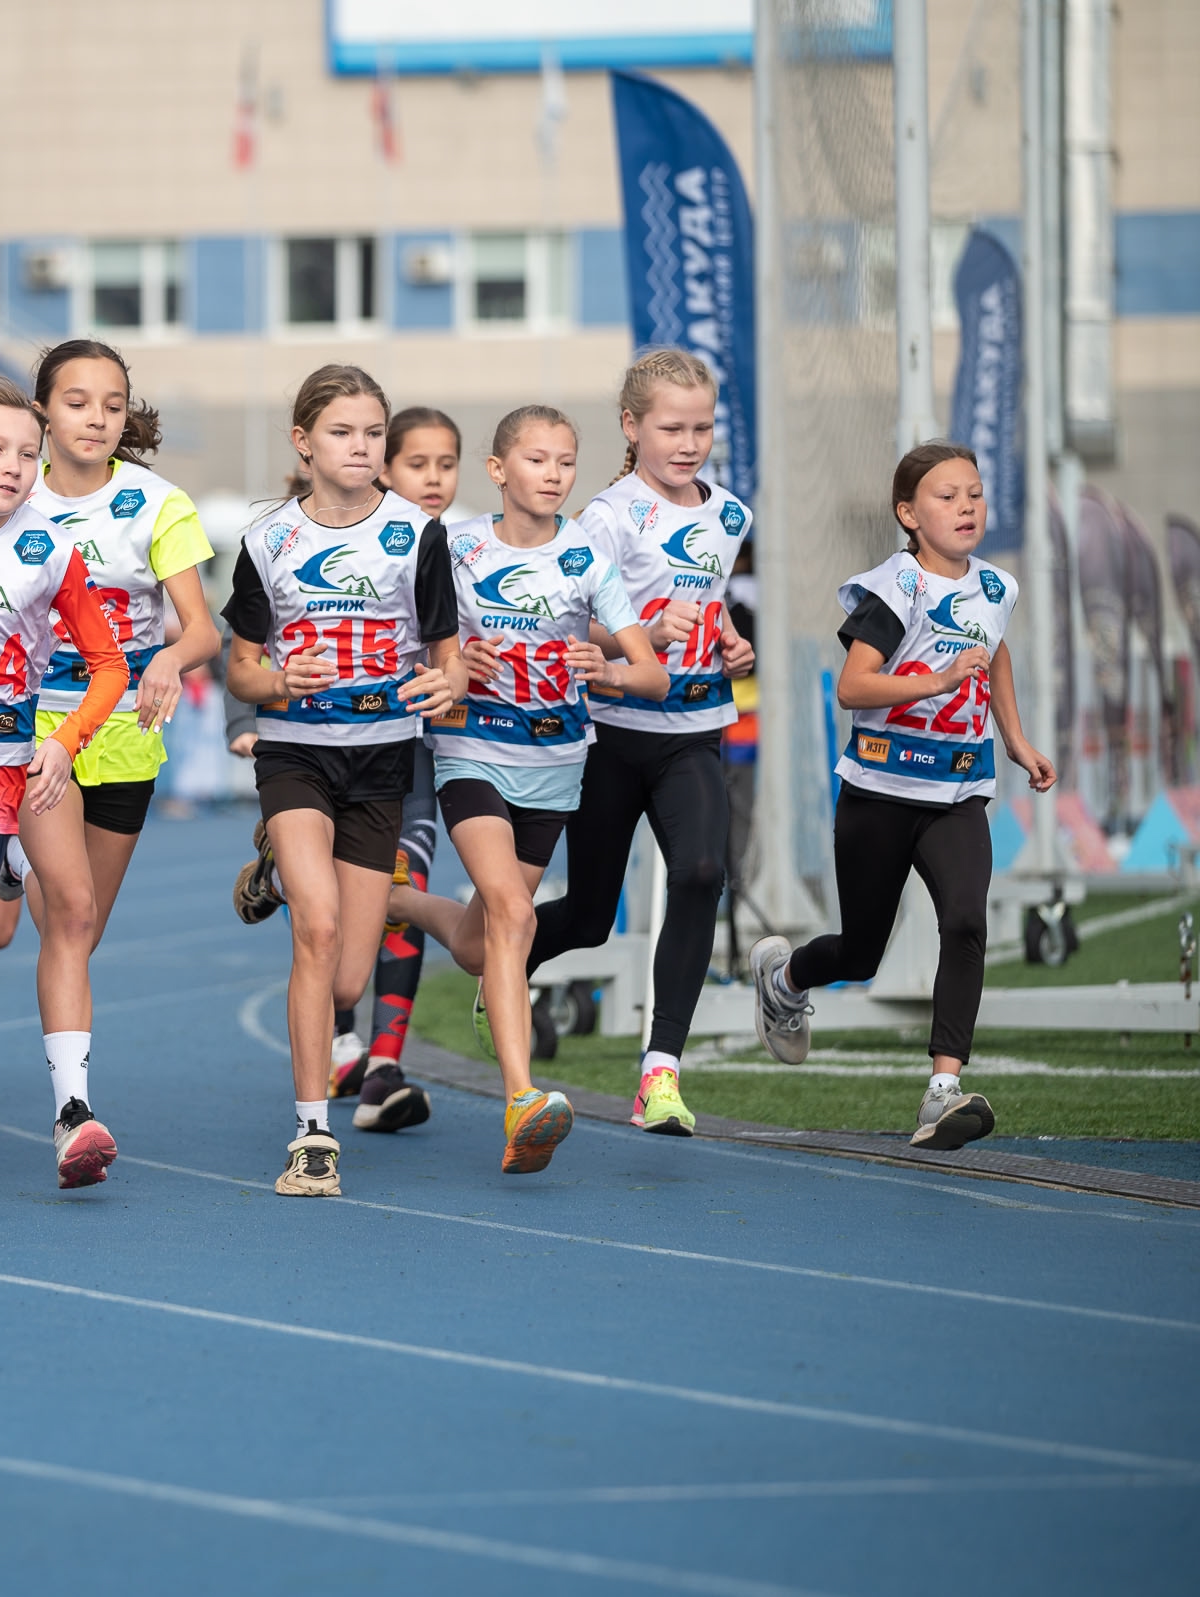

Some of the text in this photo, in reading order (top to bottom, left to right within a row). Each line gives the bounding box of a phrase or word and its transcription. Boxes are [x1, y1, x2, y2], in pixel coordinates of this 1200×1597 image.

[673, 574, 714, 590] СТРИЖ
[306, 599, 366, 613] СТРИЖ
[481, 614, 540, 631] СТРИЖ
[282, 618, 399, 680] 215
[492, 718, 514, 728] ПСБ
[913, 753, 936, 765] ПСБ
